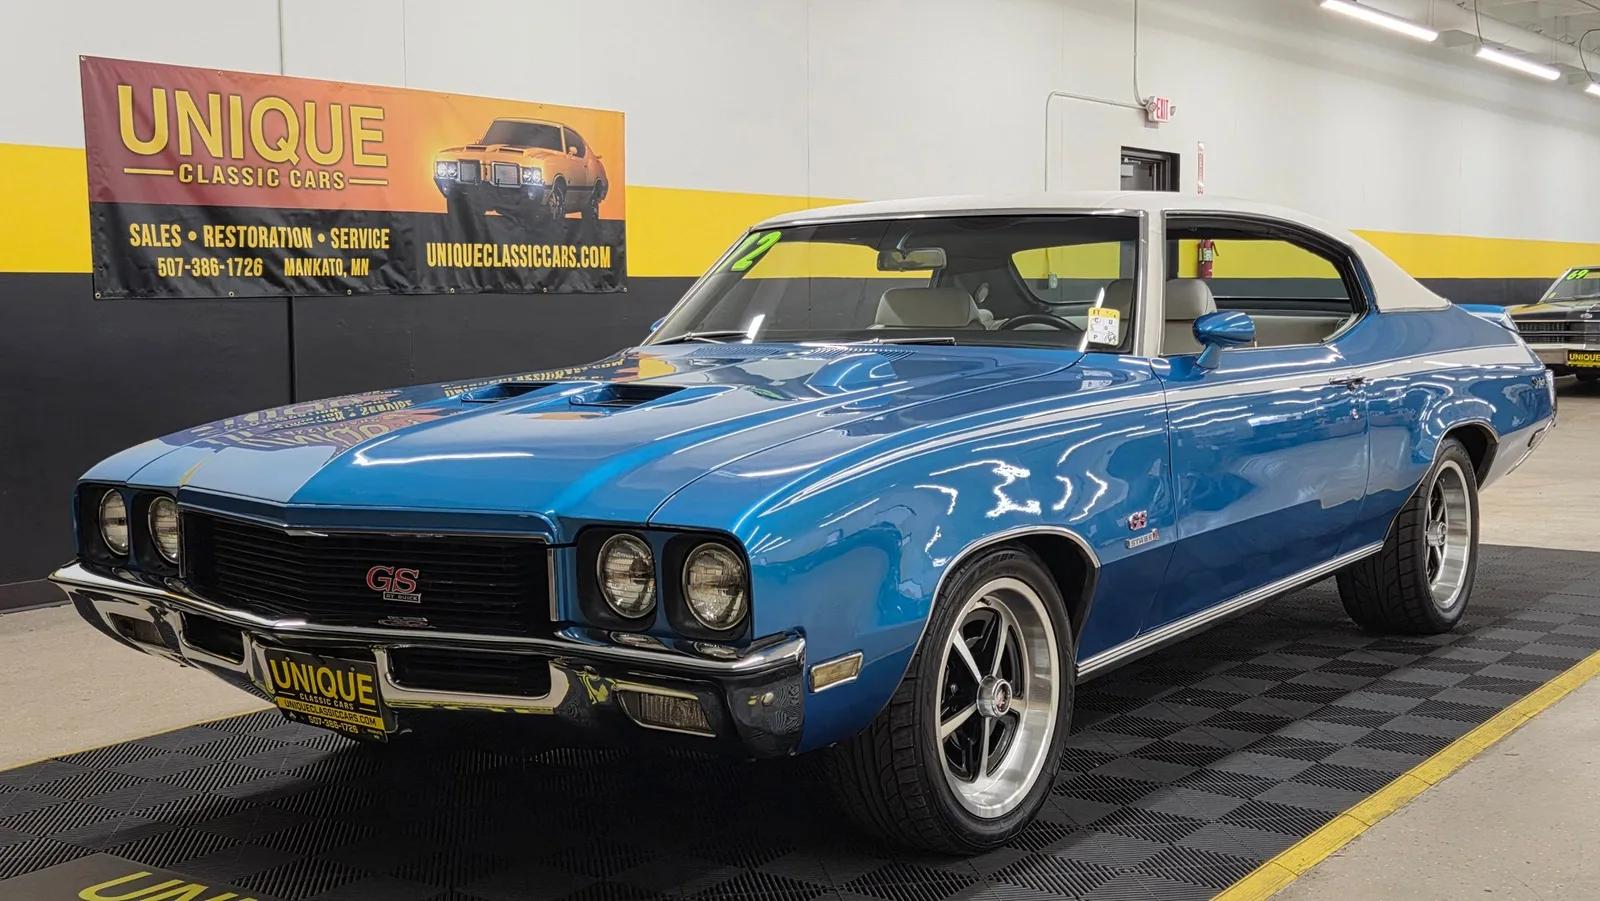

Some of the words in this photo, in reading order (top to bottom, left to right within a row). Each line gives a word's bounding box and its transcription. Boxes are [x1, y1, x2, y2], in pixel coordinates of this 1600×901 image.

[1156, 98, 1168, 120] EXIT
[117, 84, 389, 168] UNIQUE
[178, 163, 281, 187] CLASSIC
[289, 169, 346, 190] CARS
[129, 223, 182, 248] SALES
[203, 225, 313, 249] RESTORATION
[330, 228, 390, 249] SERVICE
[157, 257, 263, 277] 507-386-1726
[284, 258, 348, 279] MANKATO,
[351, 258, 370, 277] MN
[426, 243, 611, 269] UNIQUECLASSICCARS.COM
[1566, 269, 1589, 280] 69
[366, 565, 420, 595] GS
[269, 659, 376, 706] UNIQUE
[284, 700, 377, 726] UNIQUECLASSICCARS.COM
[299, 693, 332, 705] CLASSIC
[333, 700, 354, 711] CARS
[78, 870, 258, 901] UN
